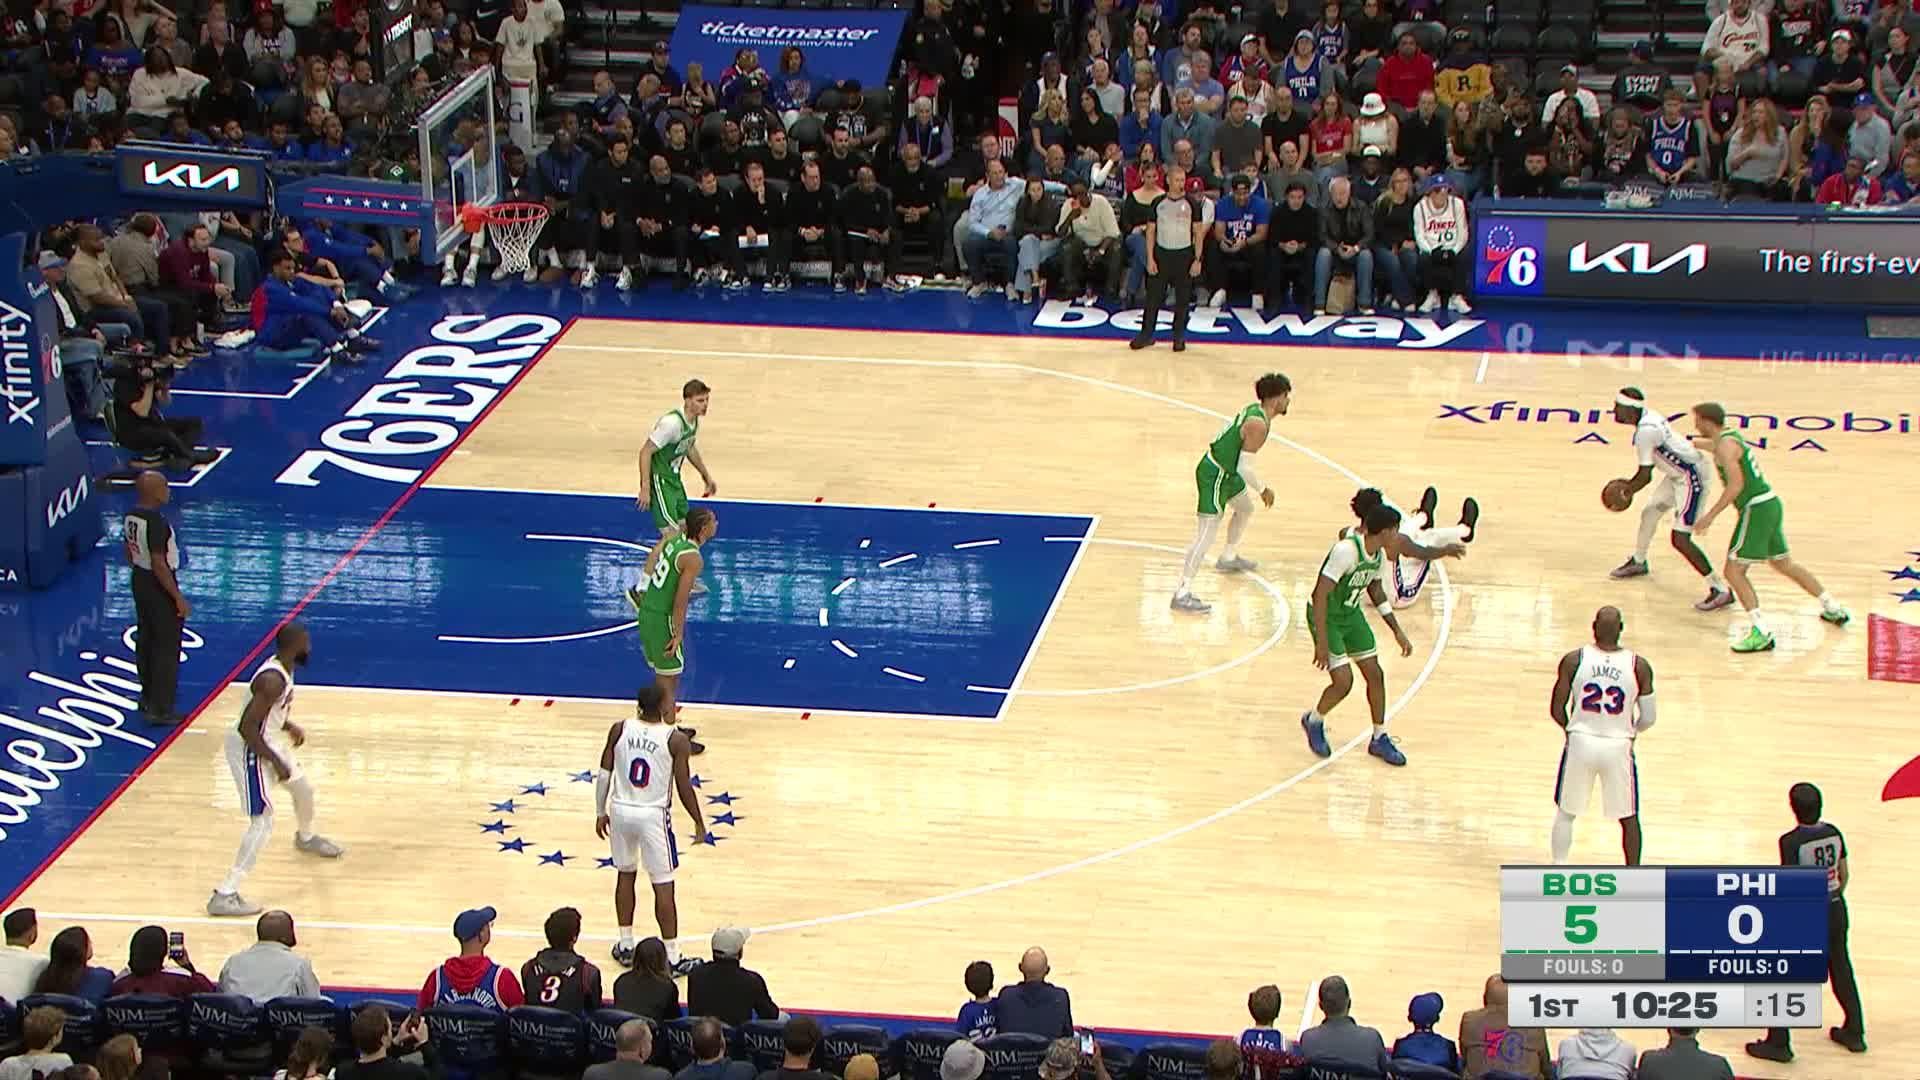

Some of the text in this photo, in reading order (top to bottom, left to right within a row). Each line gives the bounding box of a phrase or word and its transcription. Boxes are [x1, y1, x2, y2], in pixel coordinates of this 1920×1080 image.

[701, 20, 880, 41] ticketmaster
[1457, 75, 1471, 91] R
[144, 160, 240, 191] KIA
[1486, 245, 1537, 286] 76
[1569, 240, 1708, 276] KIA
[1760, 248, 1920, 274] The first-ev
[1033, 298, 1487, 349] betway
[0, 303, 40, 425] xfinity
[275, 313, 563, 487] 76ERS
[1591, 664, 1623, 682] JAMES
[1581, 682, 1626, 715] 23
[629, 757, 651, 789] 0
[1814, 843, 1836, 867] 83
[540, 975, 562, 1003] 3
[106, 1007, 144, 1022] NJM
[192, 1001, 228, 1025] NJM
[268, 1008, 304, 1025] NJM
[429, 1015, 465, 1034] NJM
[510, 1017, 544, 1036] NJM
[743, 1032, 780, 1051] NJM
[824, 1039, 859, 1056] NJM
[905, 1040, 941, 1058] NJM
[1487, 1030, 1524, 1063] 76
[1148, 1054, 1185, 1073] NJM
